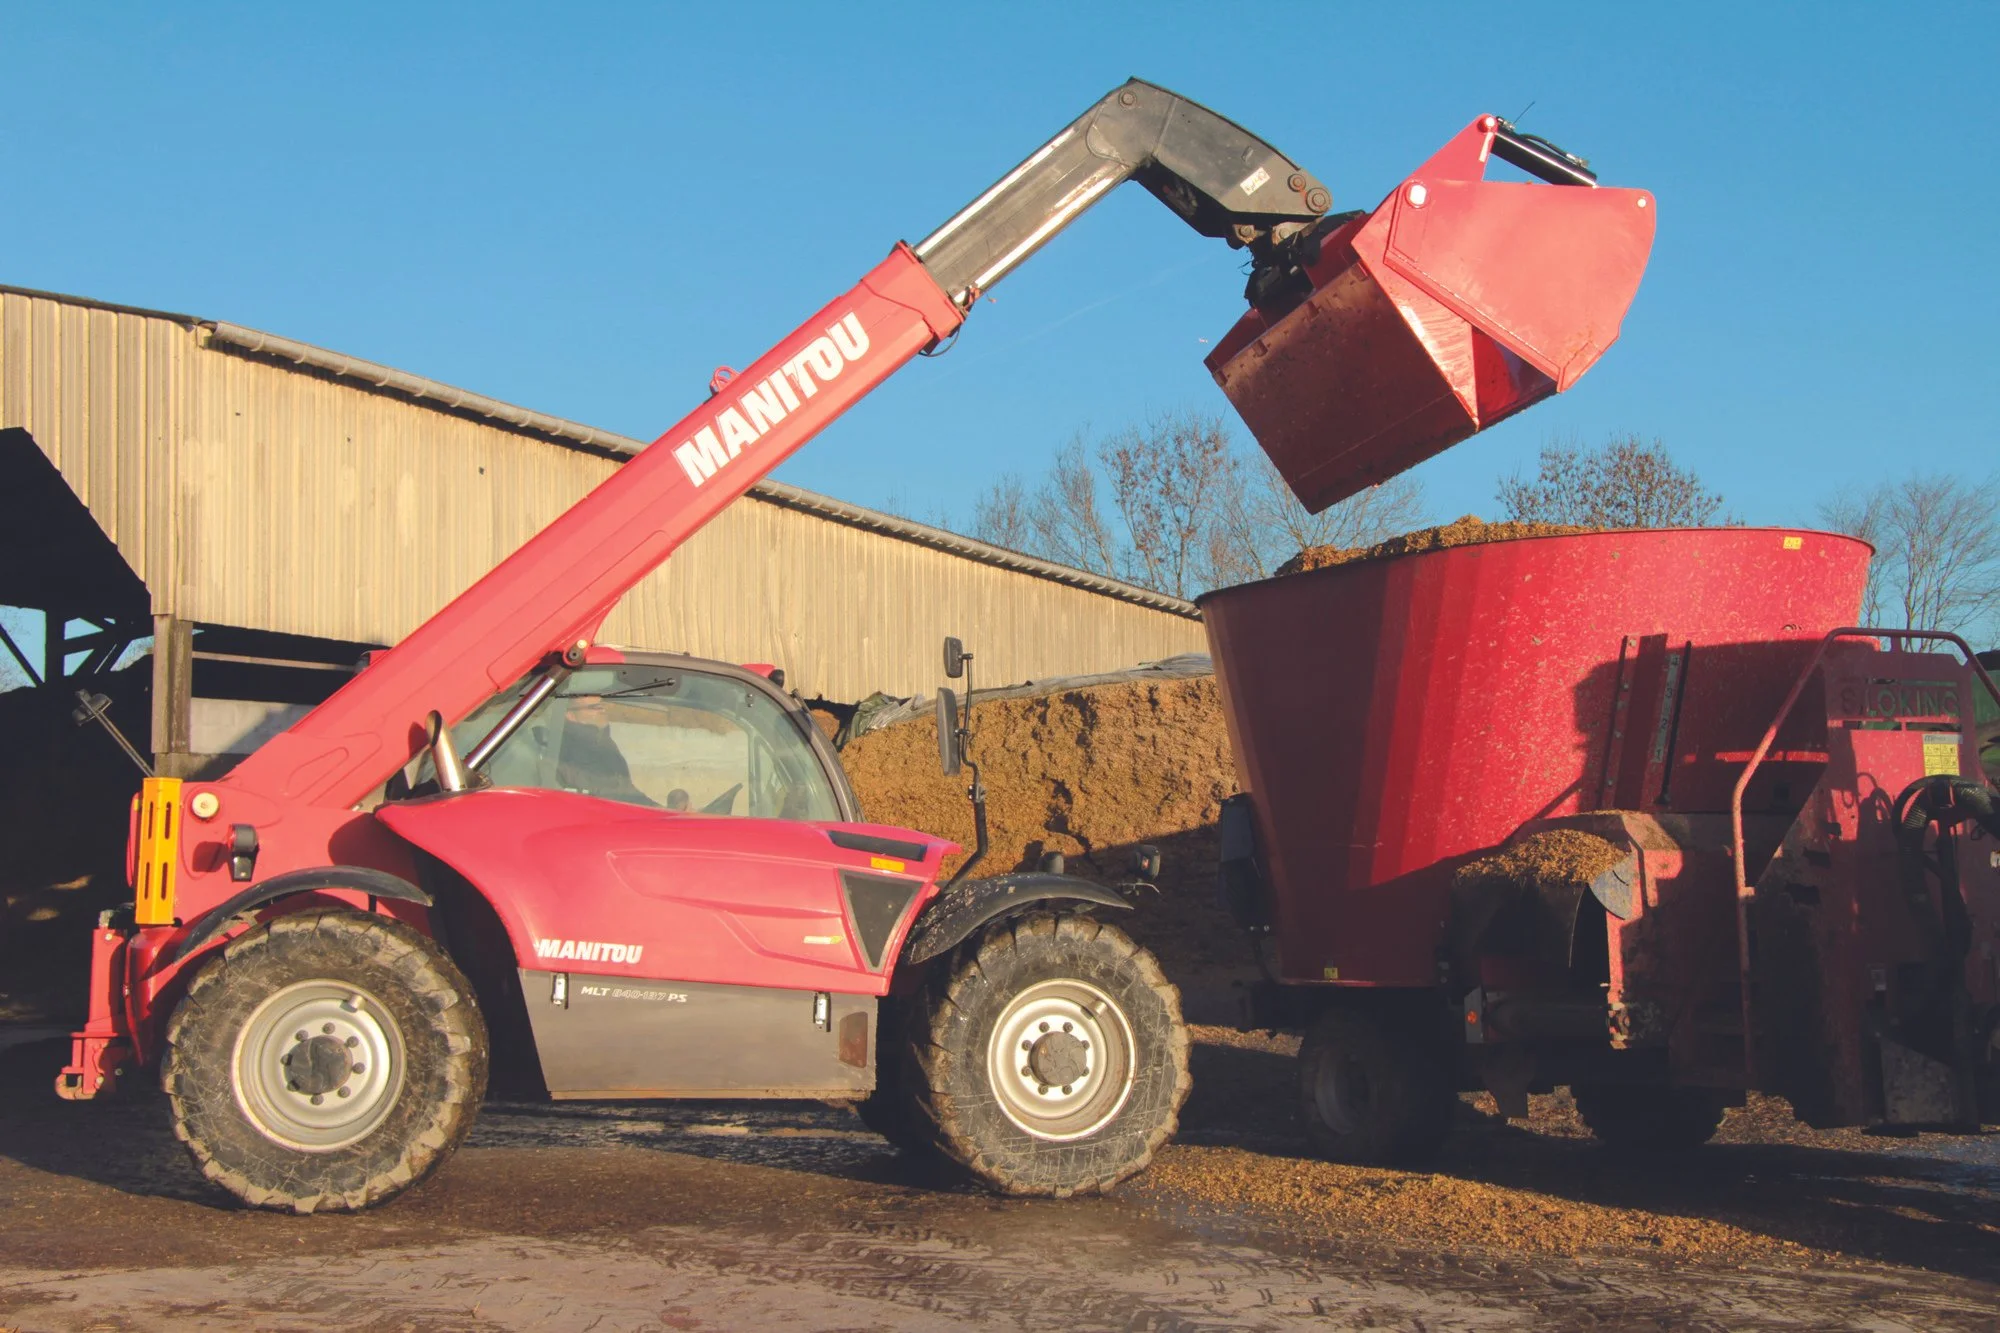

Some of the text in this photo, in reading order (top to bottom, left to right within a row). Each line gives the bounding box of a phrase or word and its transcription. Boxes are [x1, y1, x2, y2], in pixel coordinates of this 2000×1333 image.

[673, 311, 870, 488] MANITOU
[537, 939, 643, 964] MANITOU
[581, 986, 610, 996] MLT
[667, 993, 688, 1003] PS
